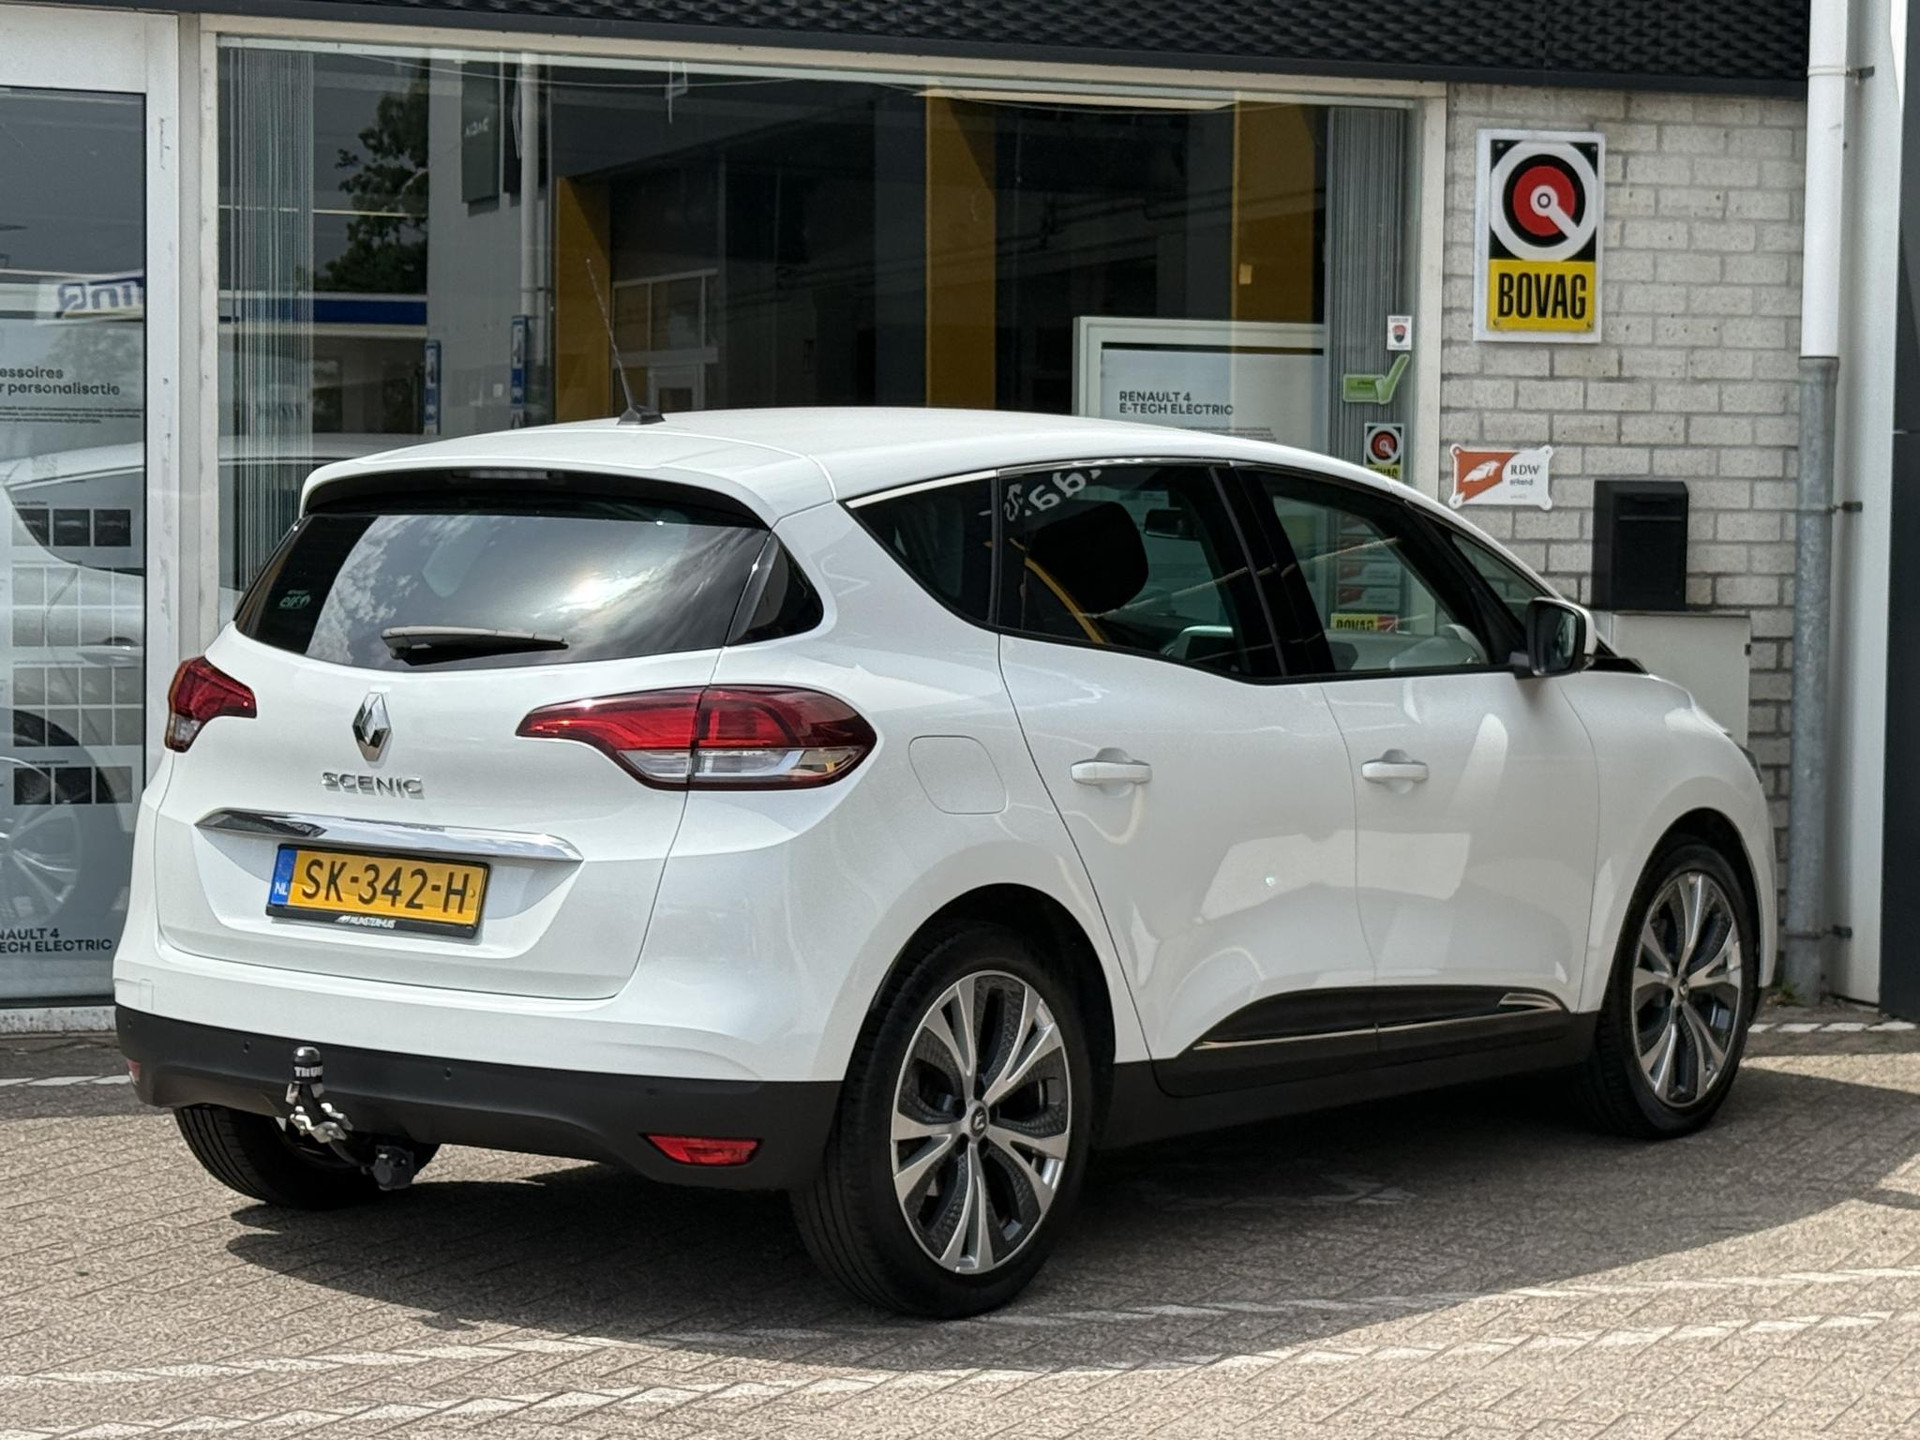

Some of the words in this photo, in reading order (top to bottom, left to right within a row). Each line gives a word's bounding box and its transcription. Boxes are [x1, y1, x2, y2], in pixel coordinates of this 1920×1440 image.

[1498, 272, 1586, 320] BOVAG
[8, 382, 120, 396] personalisatie
[1119, 391, 1180, 403] RENAULT
[1183, 392, 1192, 402] 4
[1119, 403, 1168, 414] E-TECH
[1170, 404, 1234, 416] ELECTRIC
[1510, 464, 1539, 475] RDW
[322, 772, 423, 795] SCENIC
[274, 884, 288, 896] NL
[300, 858, 471, 914] SK-342-H
[50, 928, 60, 939] 4
[35, 938, 113, 952] ELECTRIC
